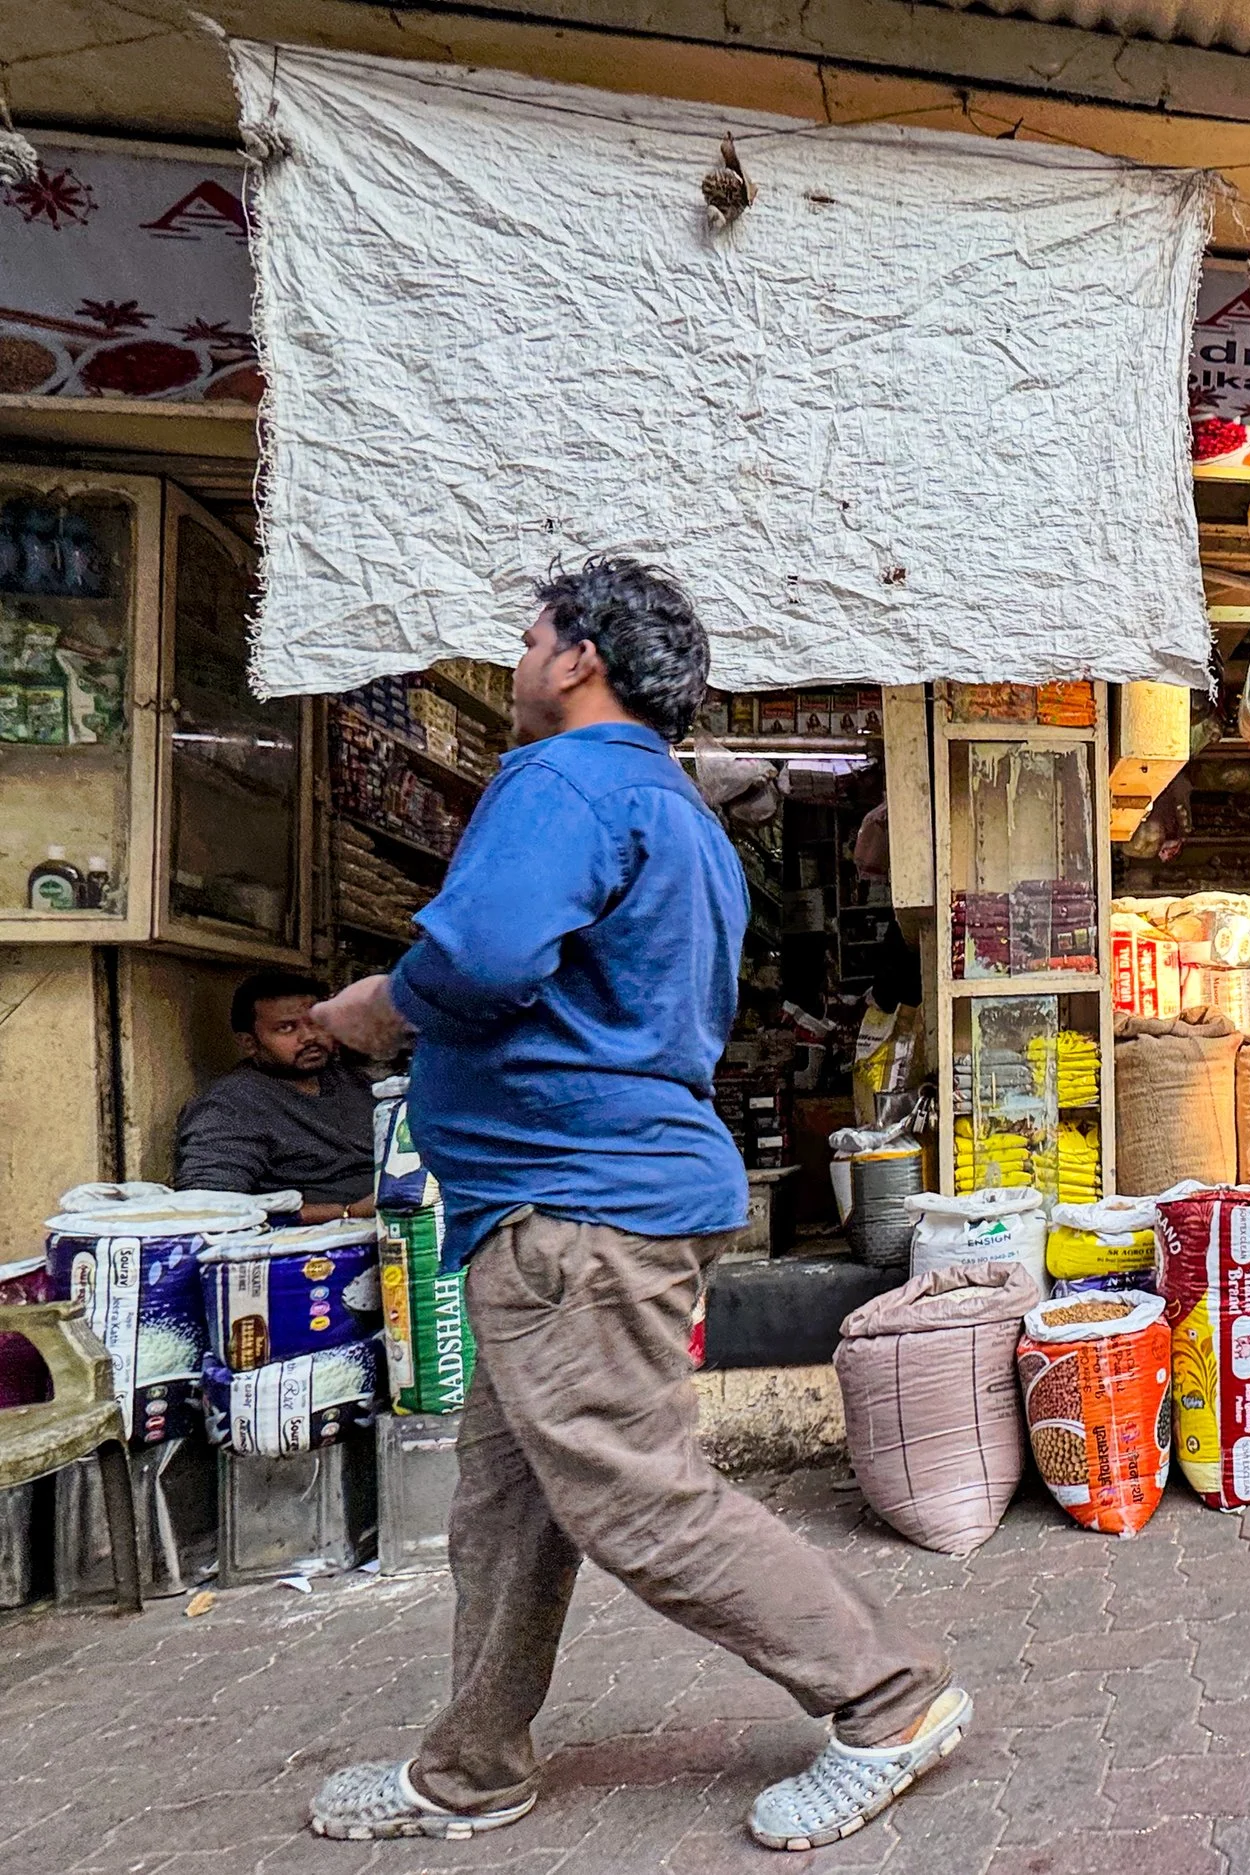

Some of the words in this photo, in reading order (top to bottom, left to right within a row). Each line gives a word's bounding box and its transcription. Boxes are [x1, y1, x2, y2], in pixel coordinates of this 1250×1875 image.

[1119, 946, 1131, 968] DAL
[1119, 972, 1132, 1002] URAD
[967, 1233, 1012, 1247] ENSIGN
[1240, 1234, 1248, 1260] CLEAN
[119, 1250, 131, 1286] Sourav
[1228, 1266, 1244, 1315] Brand
